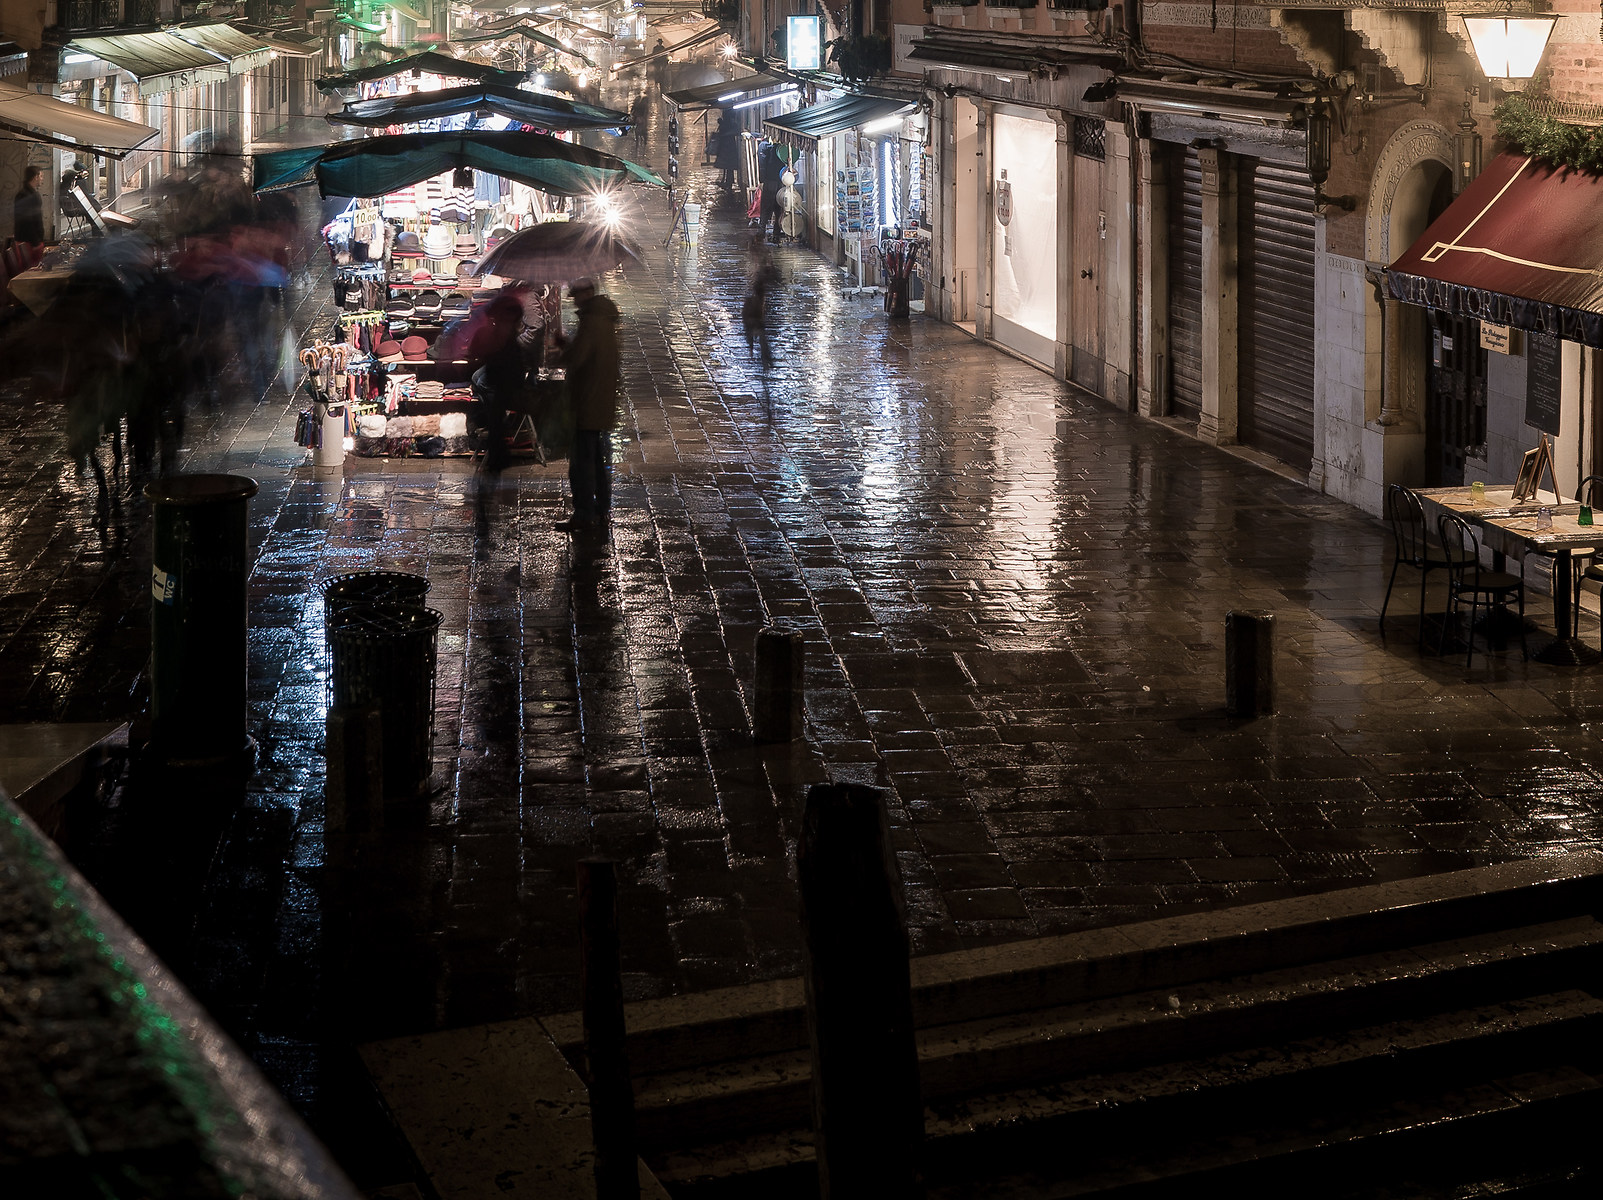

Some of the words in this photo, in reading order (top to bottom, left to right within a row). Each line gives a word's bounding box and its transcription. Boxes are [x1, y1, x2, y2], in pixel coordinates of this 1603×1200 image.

[1409, 274, 1515, 325] TRATTORIA
[1534, 304, 1587, 341] ALLA
[165, 580, 175, 598] WC
